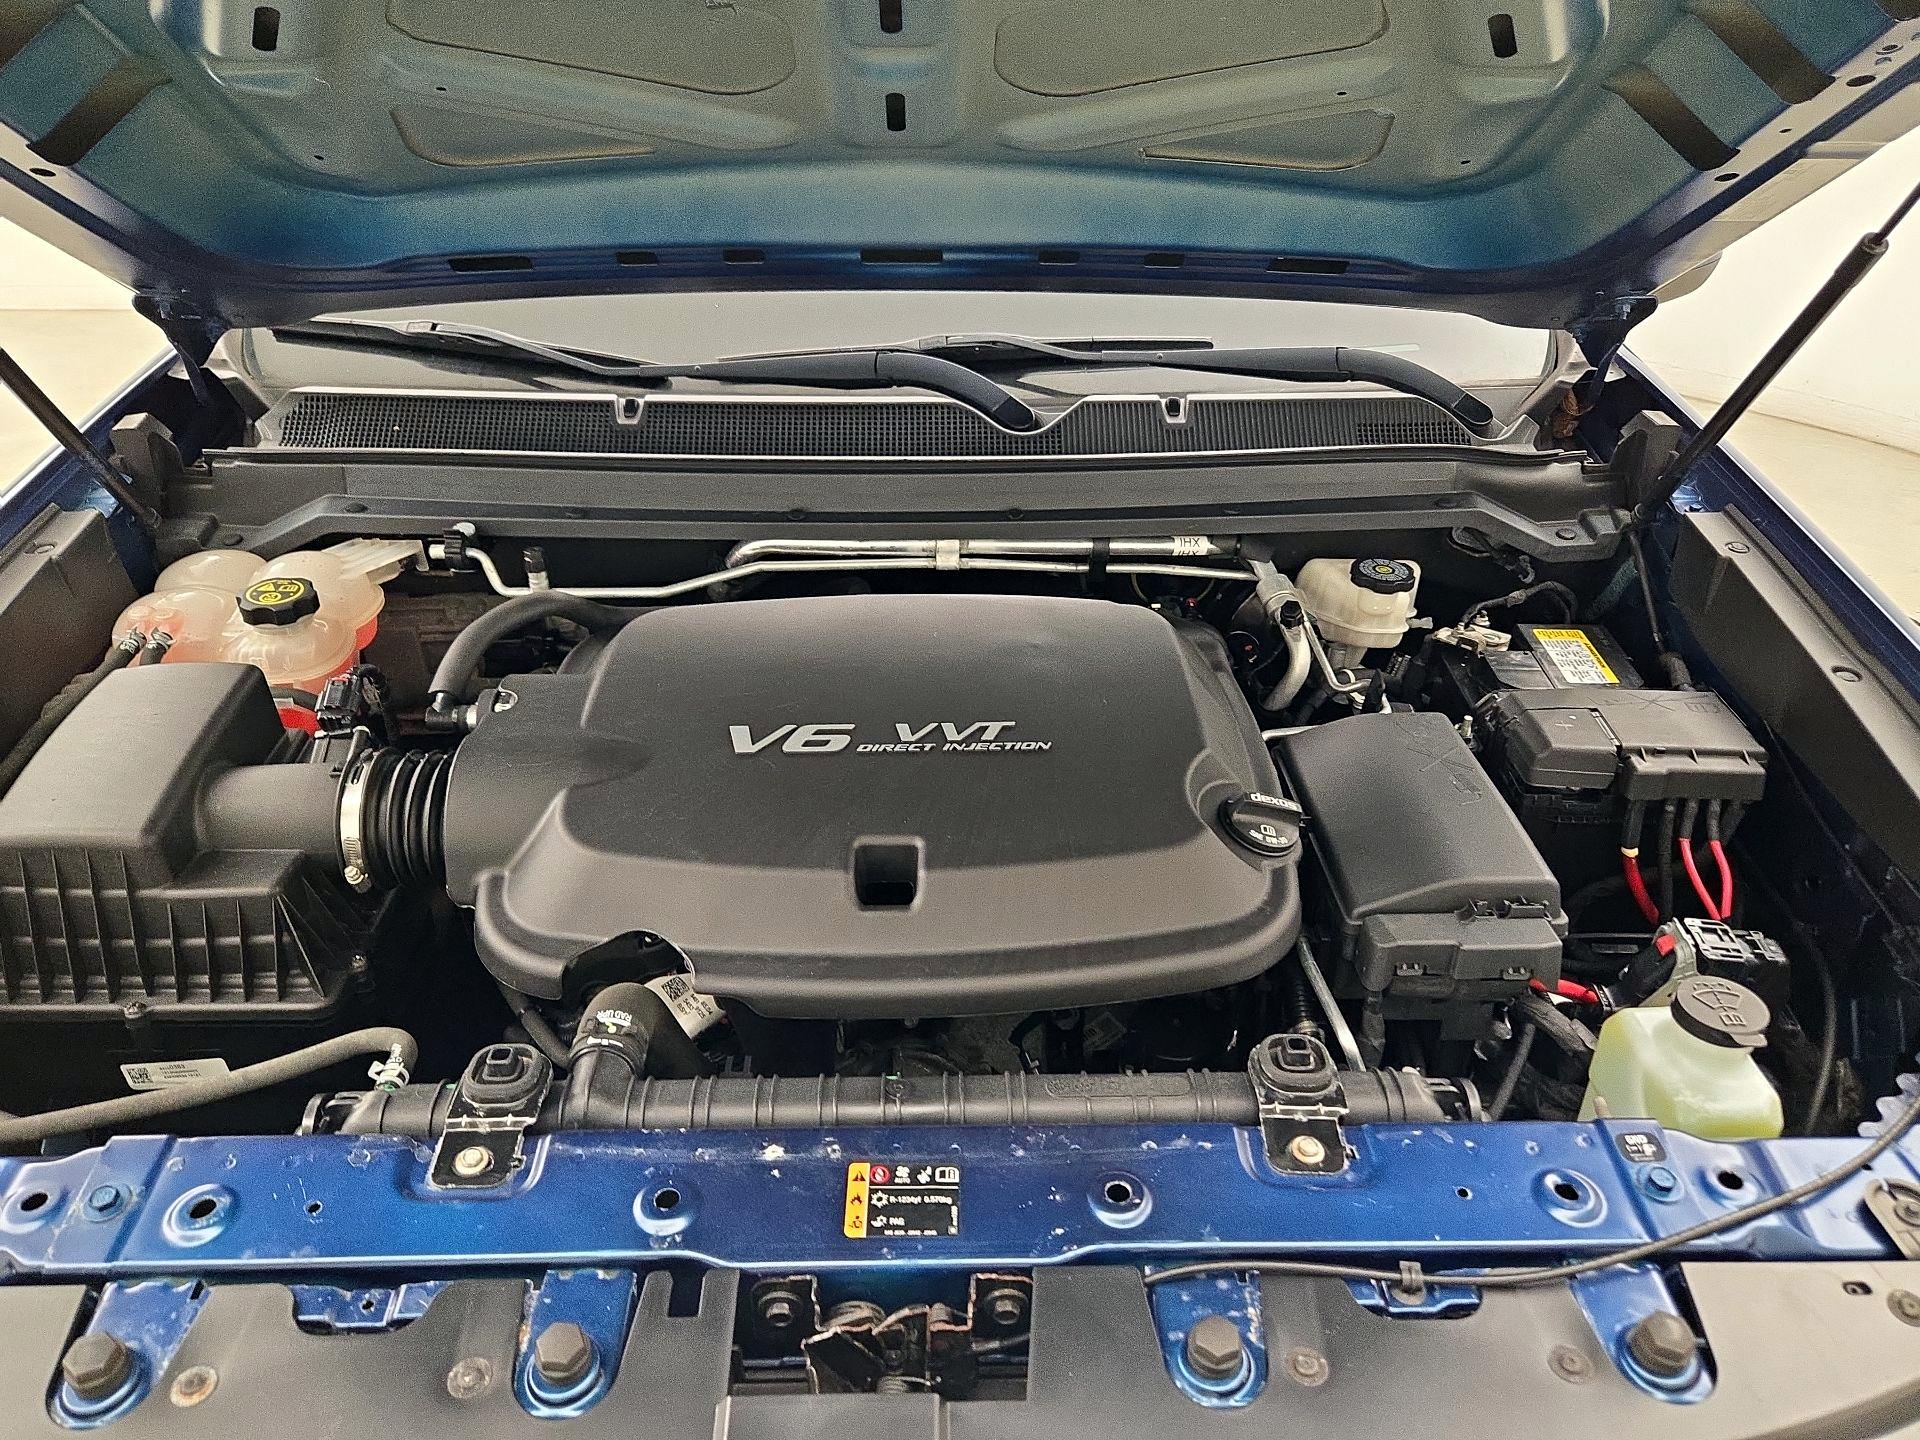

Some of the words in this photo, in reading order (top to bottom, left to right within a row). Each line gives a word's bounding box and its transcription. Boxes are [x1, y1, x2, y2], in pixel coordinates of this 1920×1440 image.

[729, 724, 855, 754] V6
[896, 721, 1016, 742] VVT
[856, 743, 936, 752] DIRECT
[942, 741, 1052, 752] INJECTION
[1250, 793, 1299, 811] dexos
[614, 1010, 632, 1022] RAD
